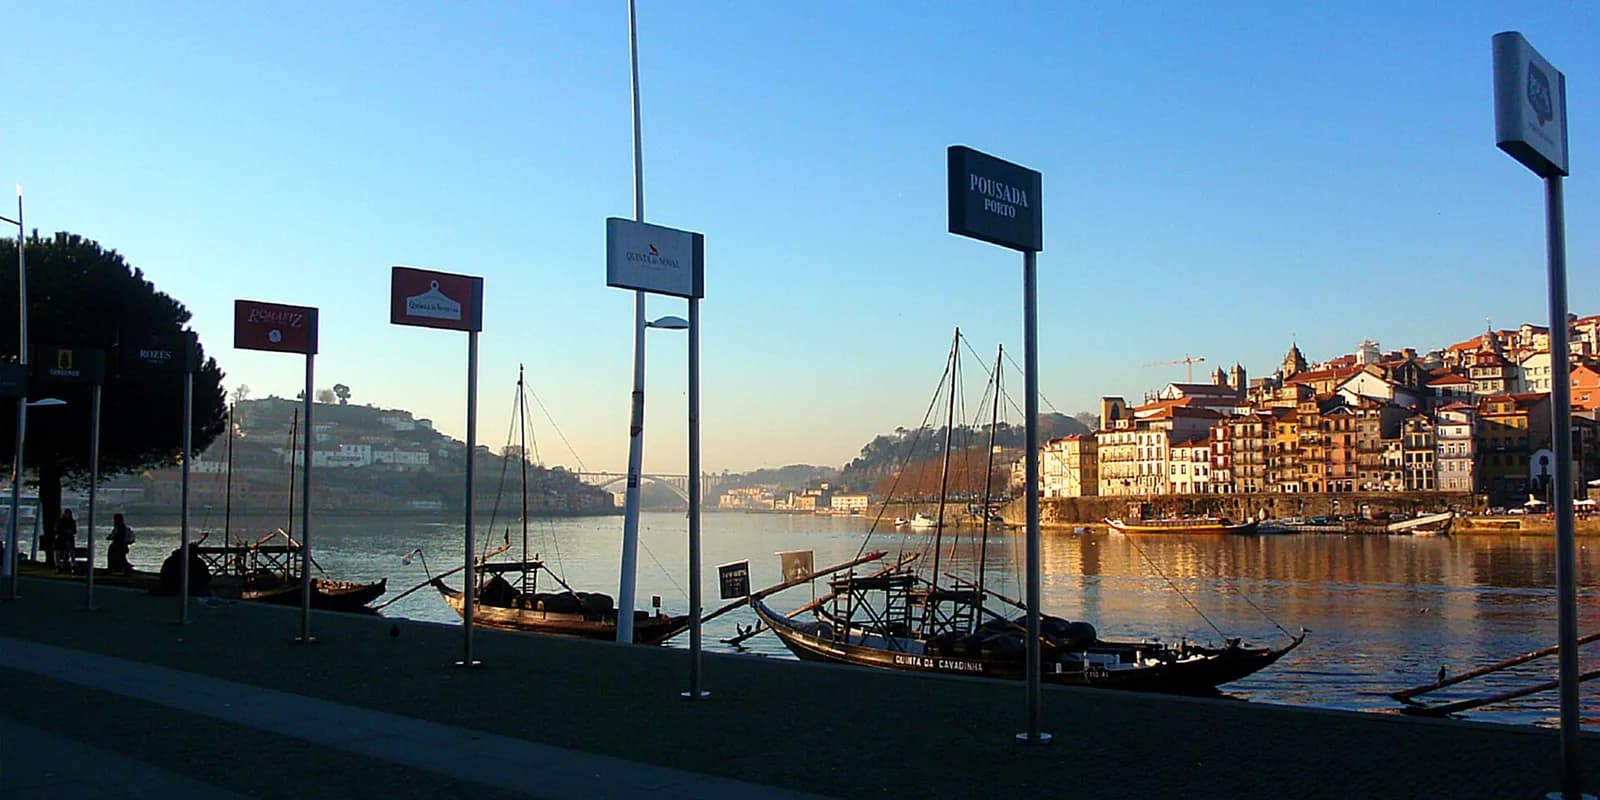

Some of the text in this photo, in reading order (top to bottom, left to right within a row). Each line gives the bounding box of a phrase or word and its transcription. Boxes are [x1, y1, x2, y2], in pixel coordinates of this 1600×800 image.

[969, 173, 1028, 208] POUSADA
[984, 198, 1016, 218] PORTO
[895, 655, 983, 672] QUINTA DA CAVADINHA
